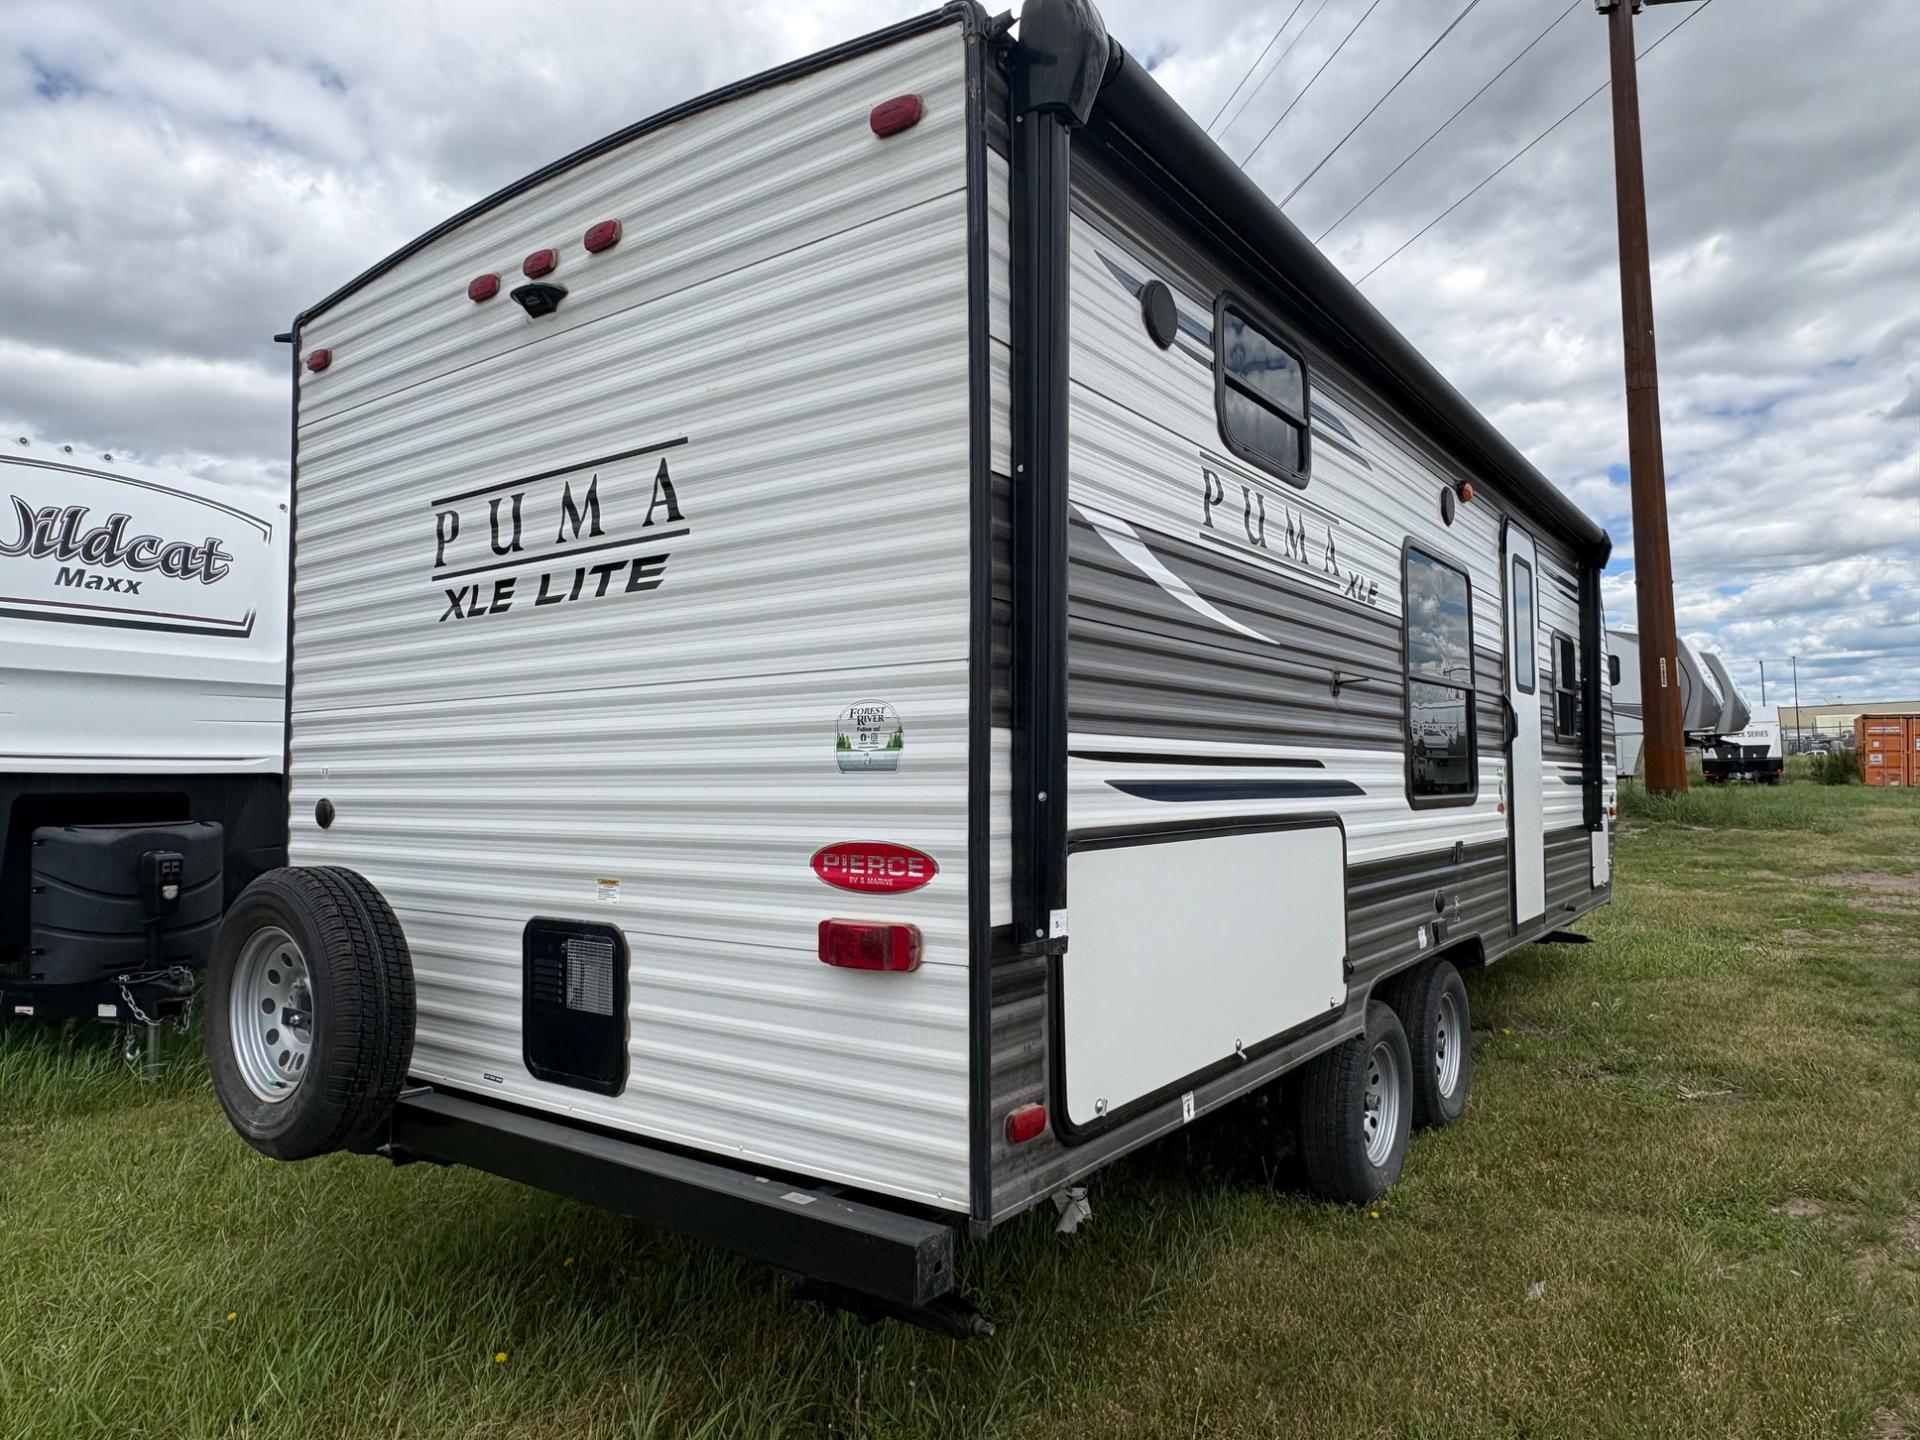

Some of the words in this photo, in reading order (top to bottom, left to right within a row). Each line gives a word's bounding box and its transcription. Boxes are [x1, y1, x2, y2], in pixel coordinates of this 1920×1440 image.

[434, 456, 686, 568] PUMA
[1200, 465, 1341, 578] PUMA
[54, 566, 143, 595] Maxx
[438, 577, 518, 623] XLE
[534, 553, 671, 606] LITE
[1344, 570, 1380, 606] XLE
[848, 706, 886, 720] FOREST
[857, 714, 885, 726] RIVER
[823, 853, 925, 878] PIERCE
[867, 877, 893, 886] MARINE
